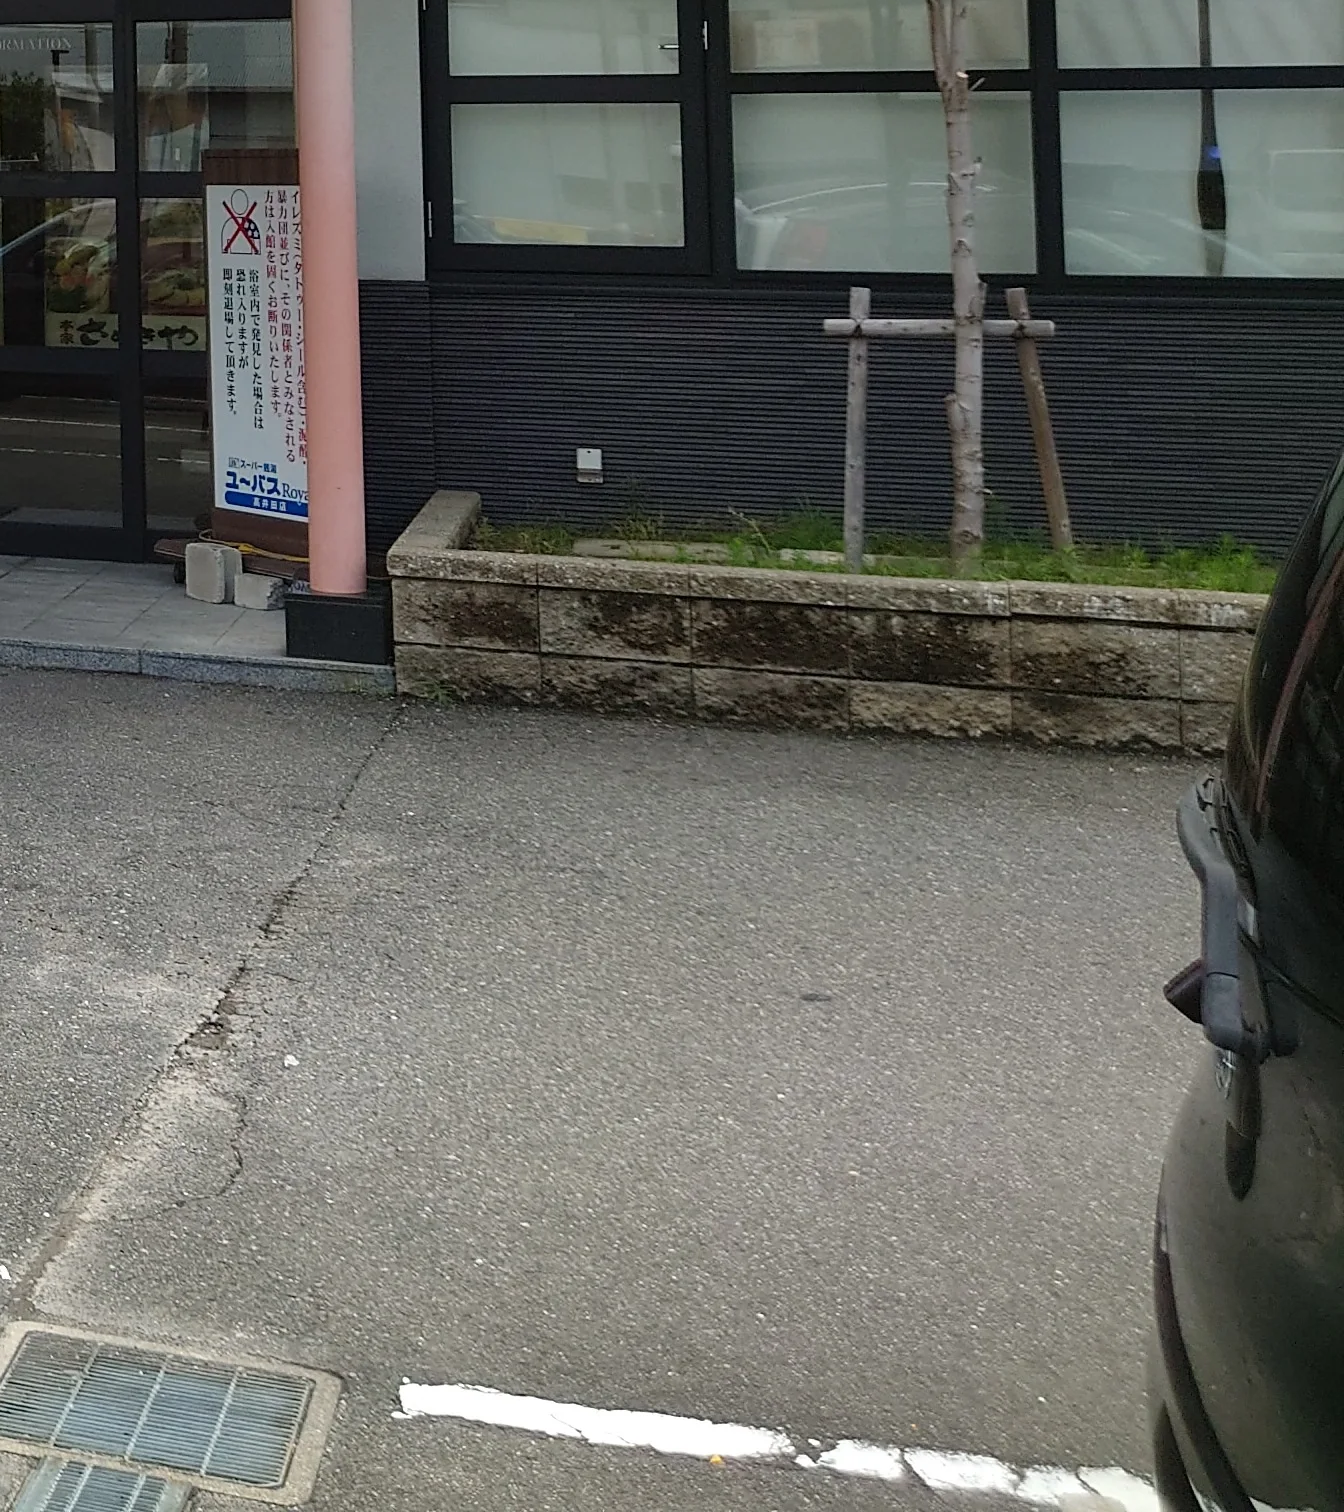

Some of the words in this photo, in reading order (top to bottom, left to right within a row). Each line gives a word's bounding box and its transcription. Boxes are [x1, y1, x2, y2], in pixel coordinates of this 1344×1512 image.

[236, 268, 249, 370] 恐れ入りますが
[253, 497, 287, 513] 高井田店
